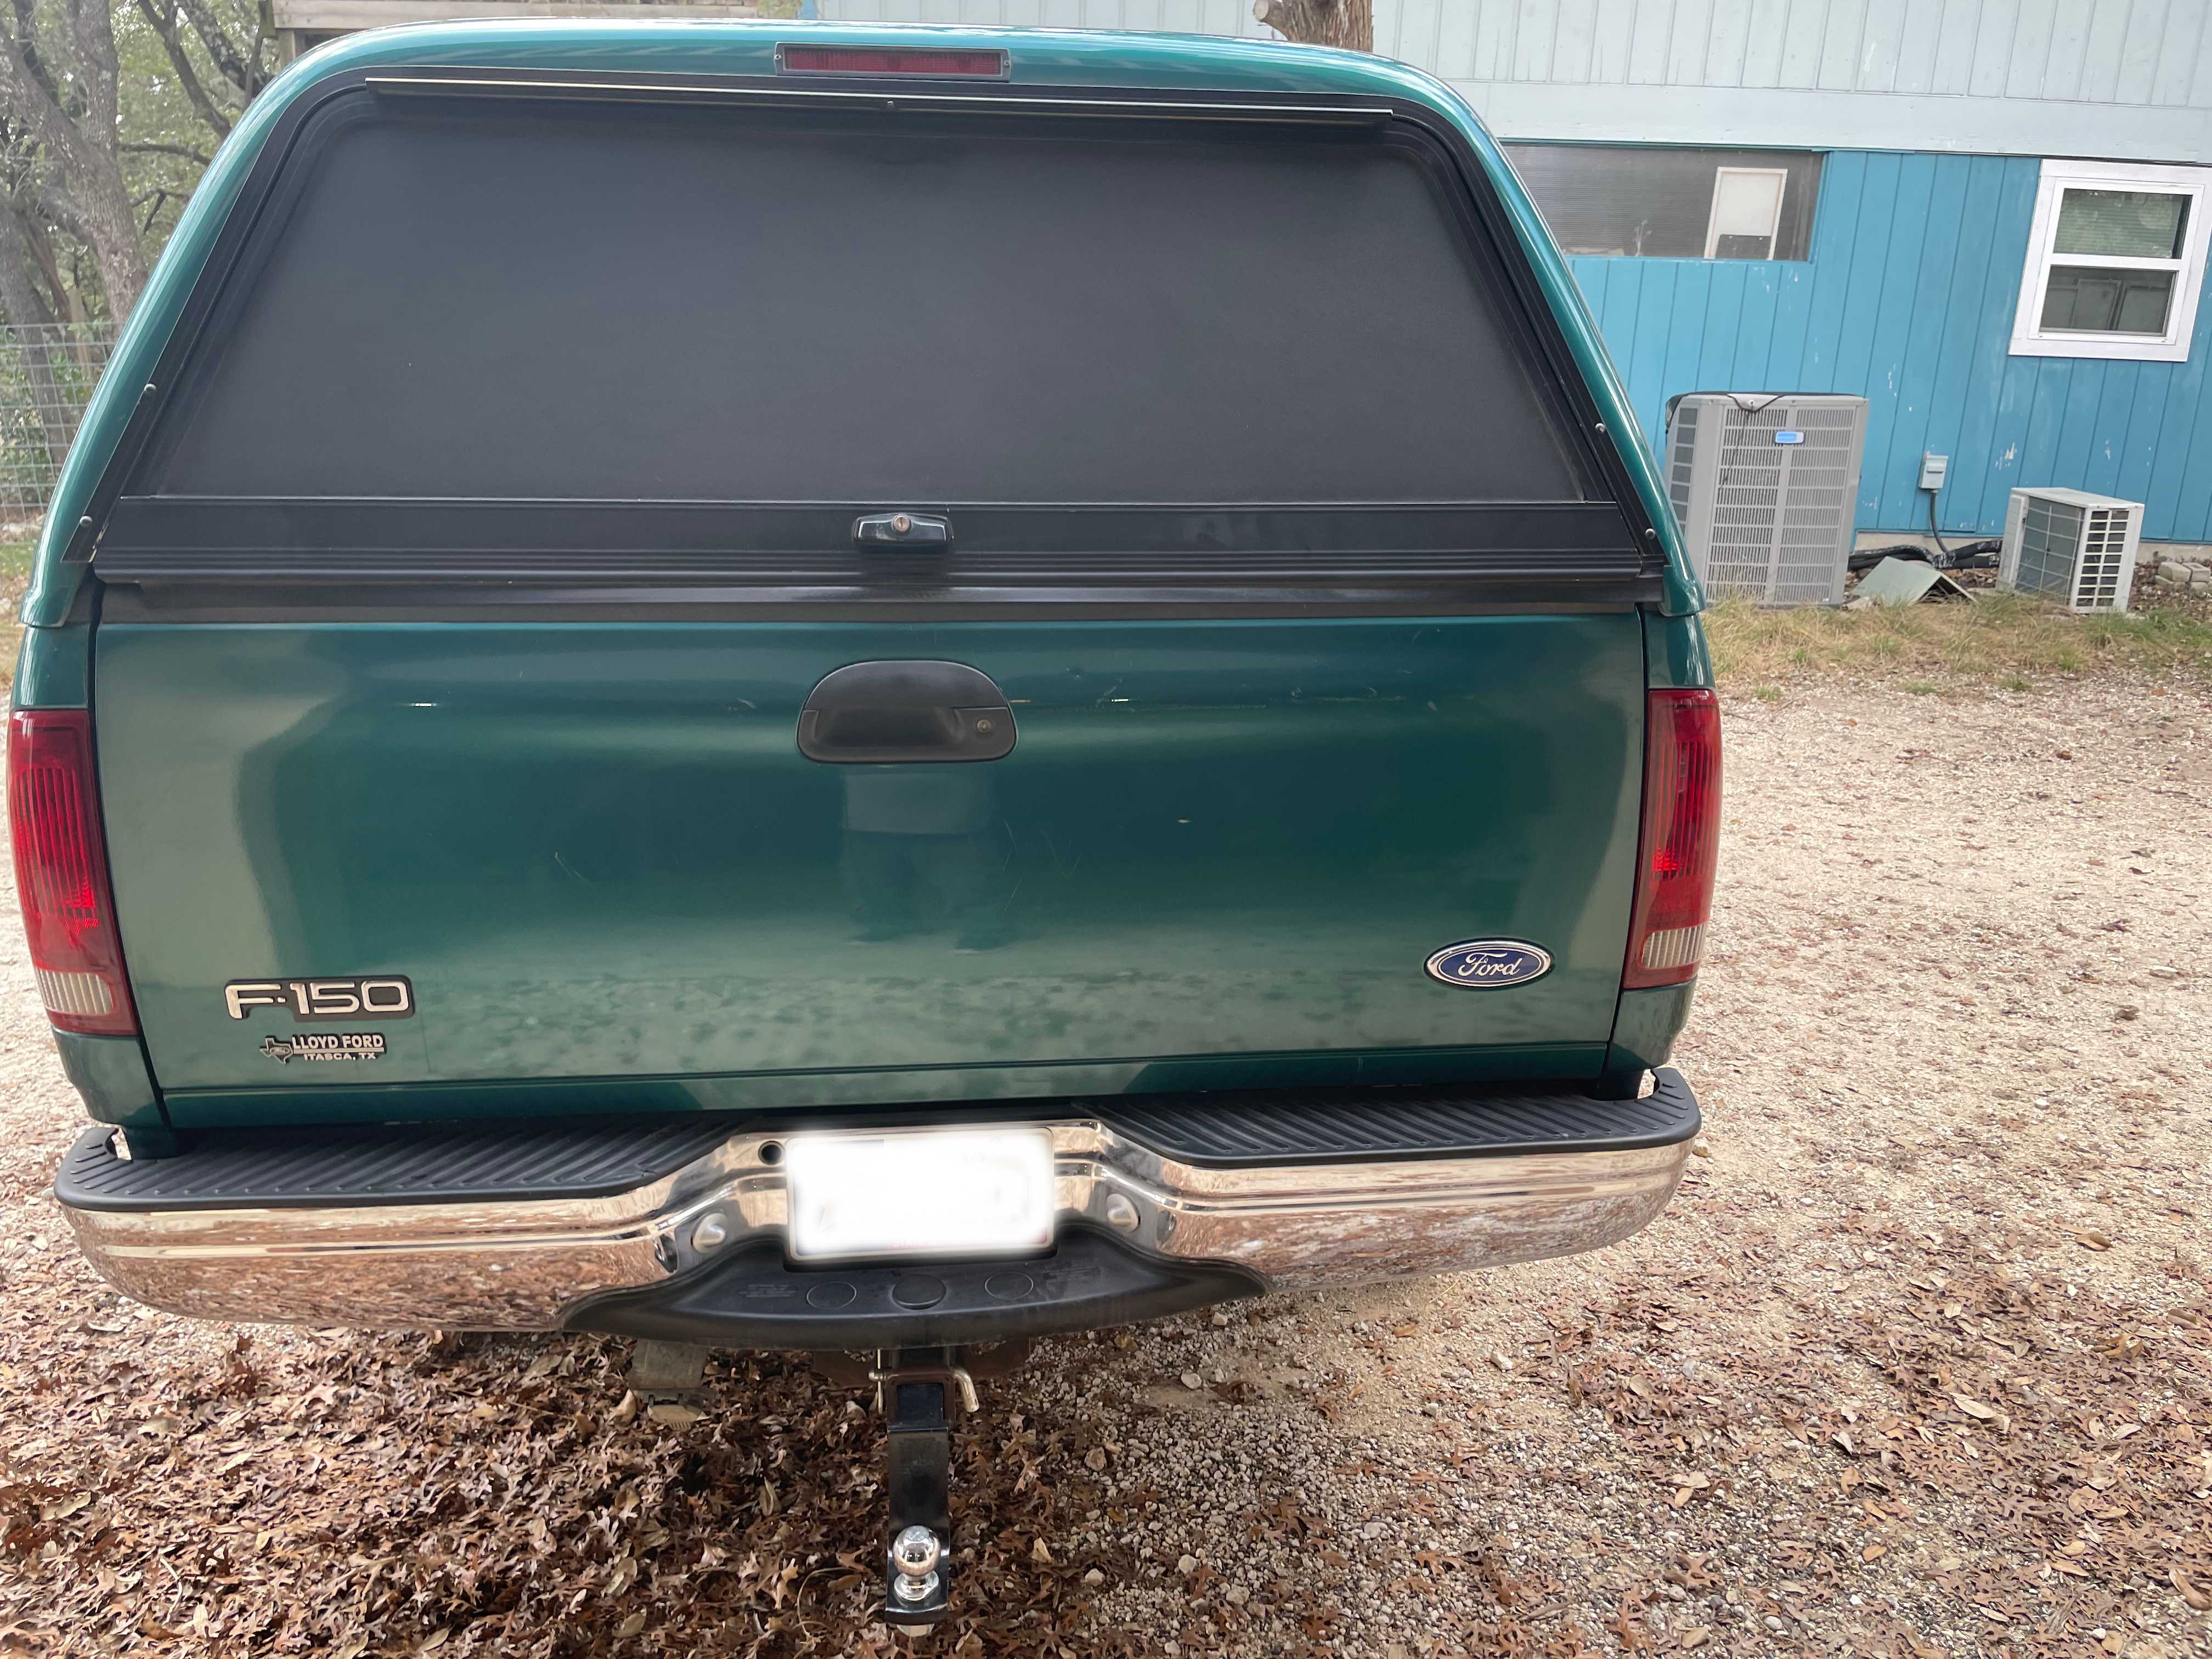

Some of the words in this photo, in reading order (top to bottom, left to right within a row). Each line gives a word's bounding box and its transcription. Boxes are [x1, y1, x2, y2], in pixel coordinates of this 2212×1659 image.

[1458, 952, 1522, 977] Ford
[291, 1035, 338, 1049] LLOYD
[342, 1035, 383, 1048] FORD
[304, 1052, 357, 1061] ITASCA,
[358, 1052, 376, 1060] TX
